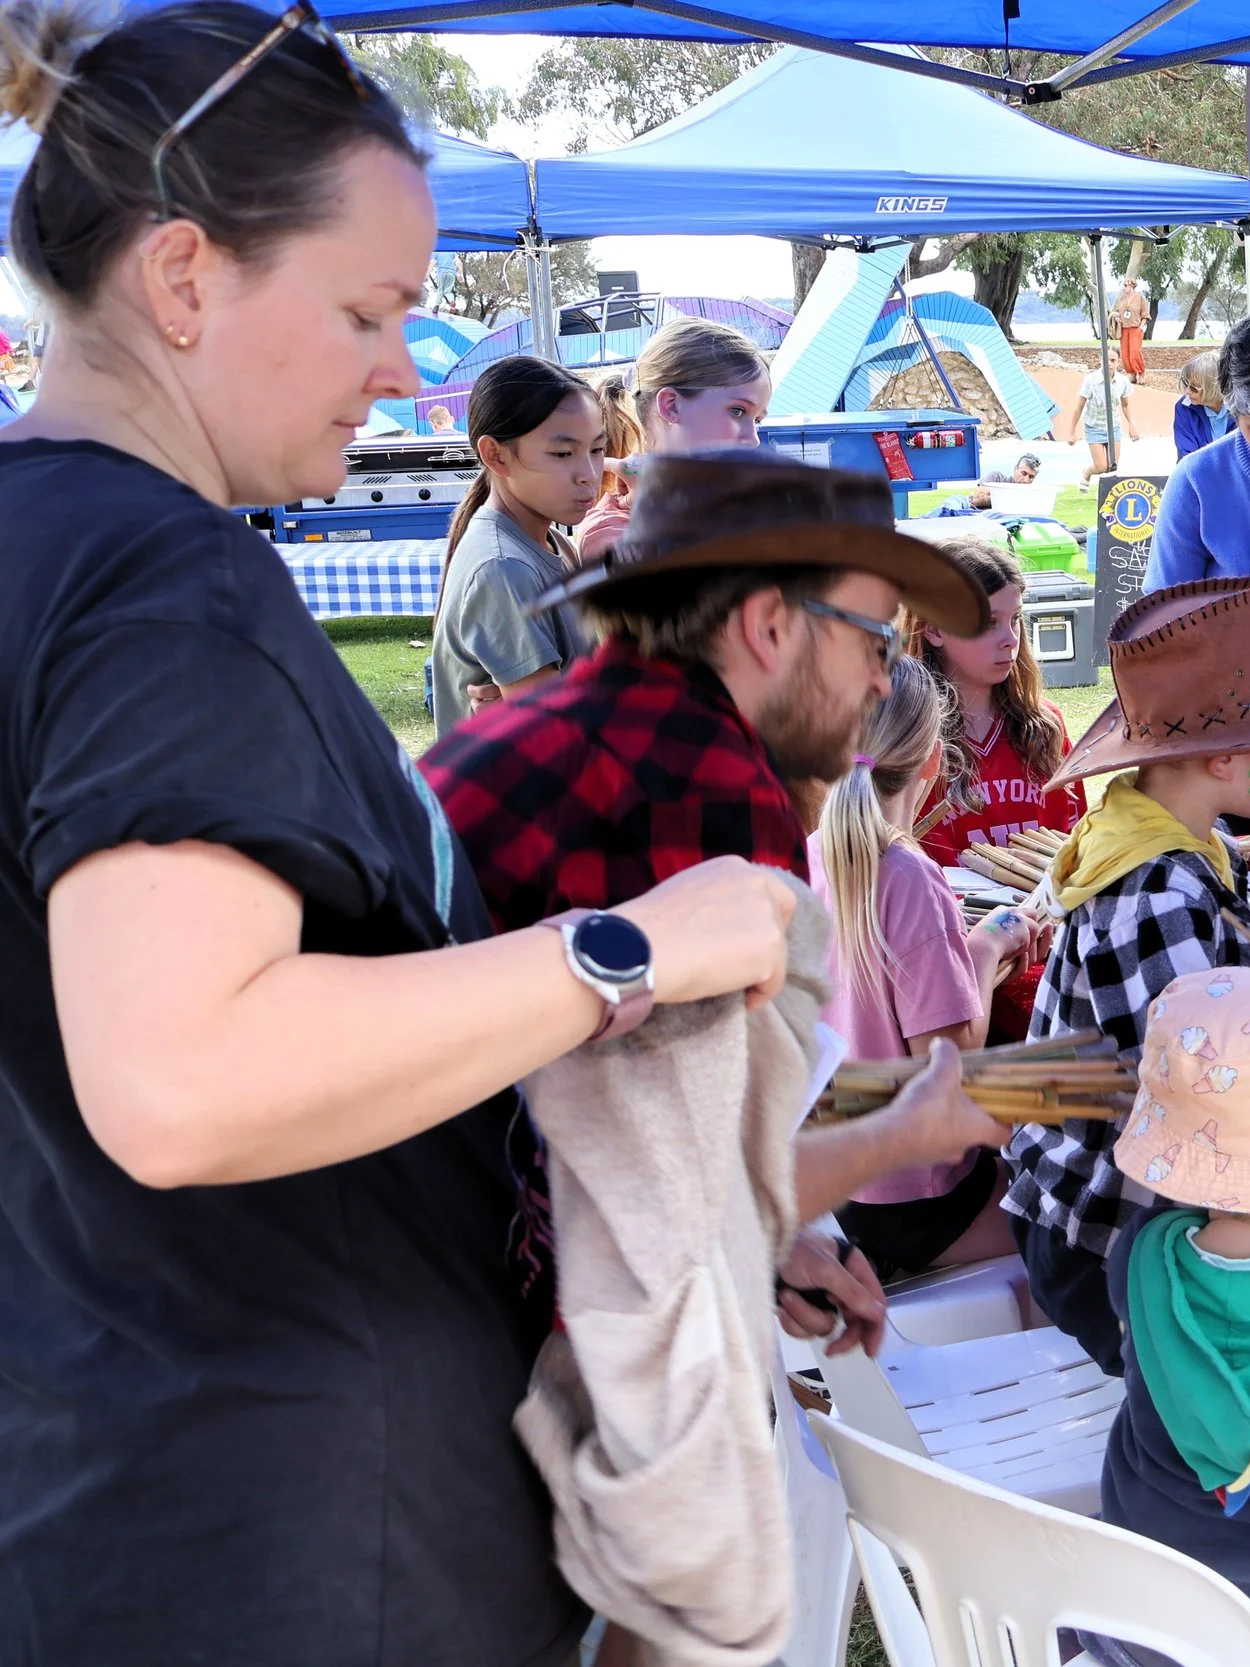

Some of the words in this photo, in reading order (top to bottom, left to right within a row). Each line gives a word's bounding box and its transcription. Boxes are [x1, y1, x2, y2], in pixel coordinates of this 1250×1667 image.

[876, 196, 948, 213] KINGS
[1115, 480, 1154, 495] LIONS
[1125, 498, 1143, 521] L
[1113, 527, 1151, 540] INTERNATIONAL
[993, 778, 1047, 809] YOR
